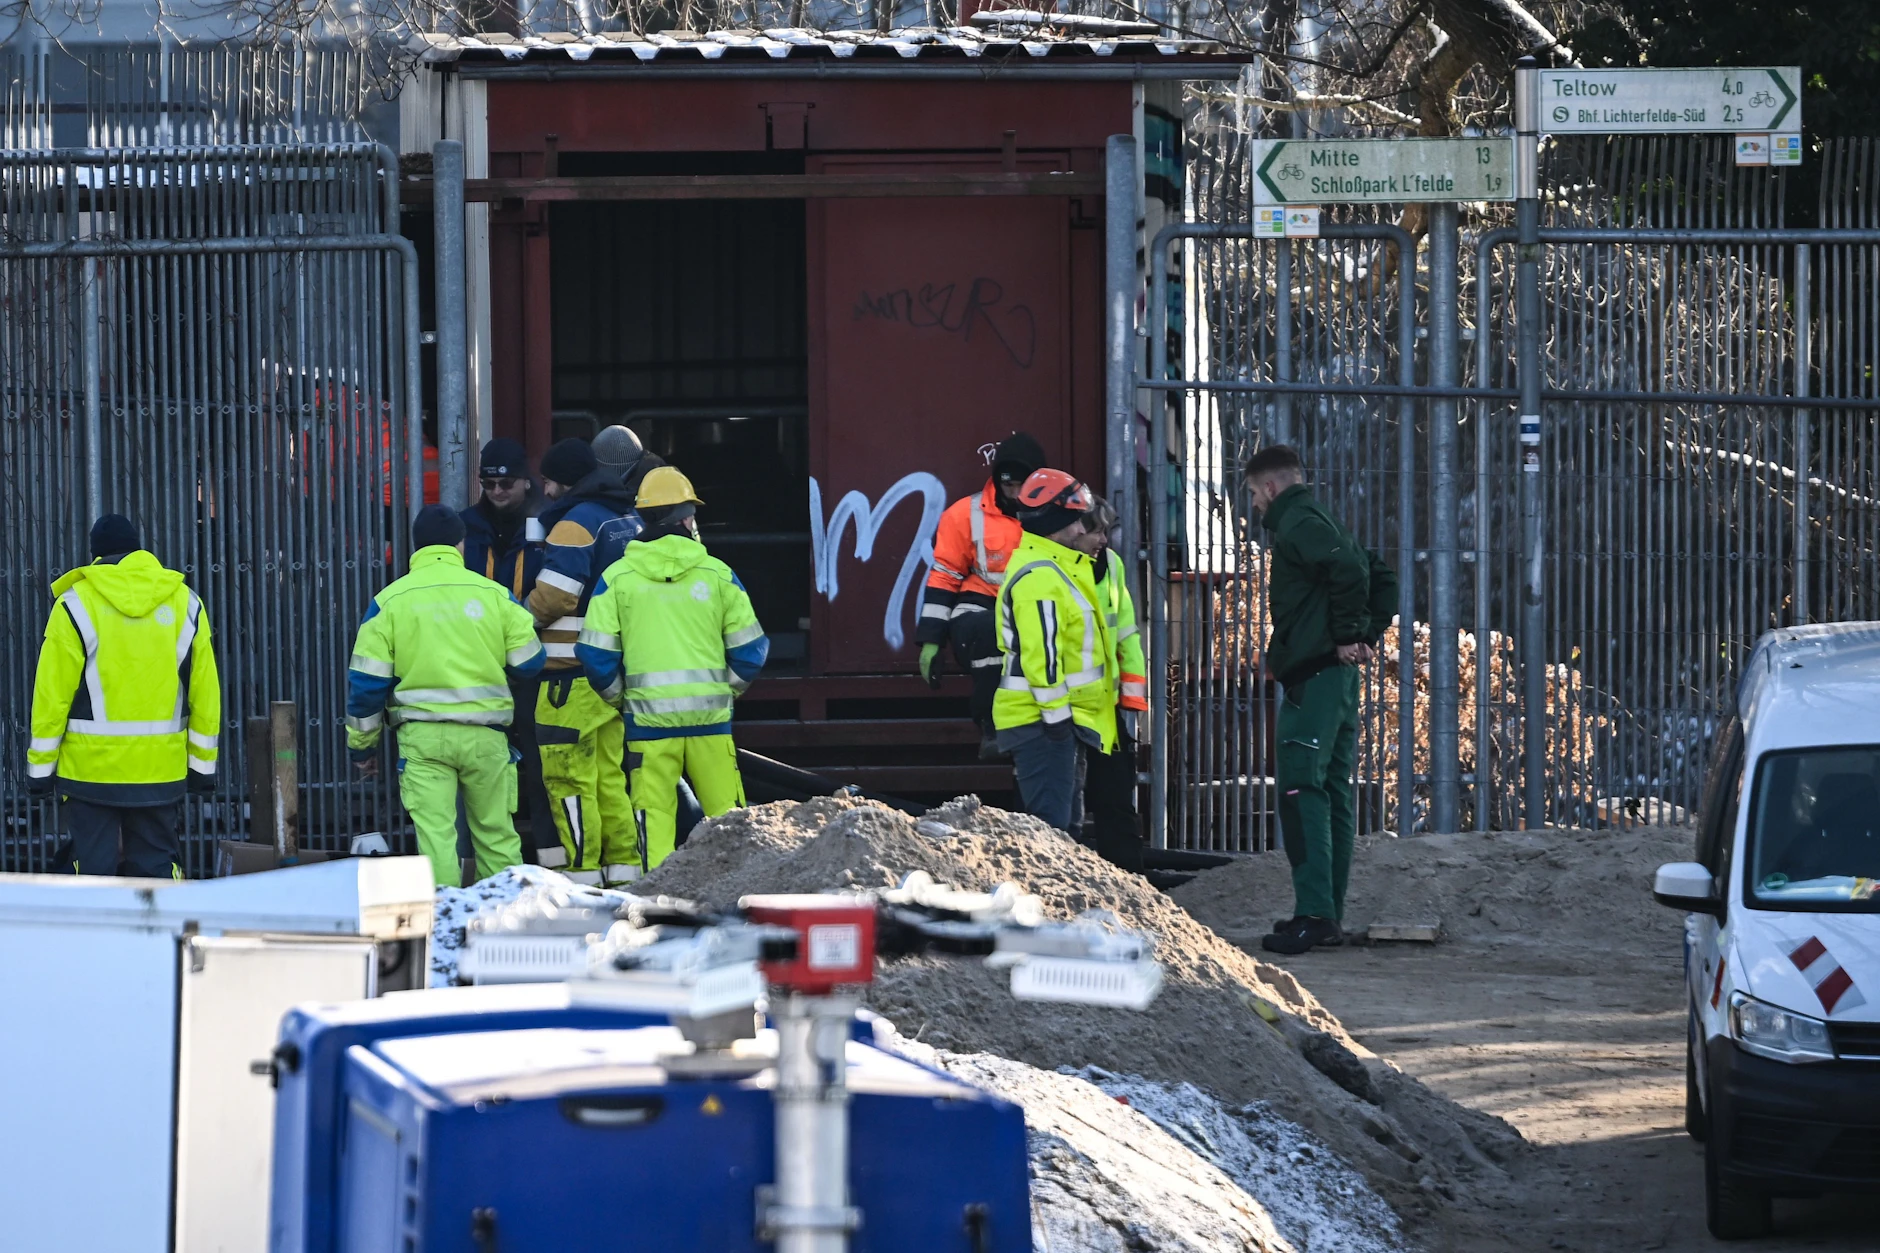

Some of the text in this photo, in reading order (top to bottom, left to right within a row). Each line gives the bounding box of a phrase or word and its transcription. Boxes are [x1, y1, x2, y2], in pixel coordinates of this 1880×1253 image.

[1552, 79, 1616, 97] Teltow
[1578, 109, 1600, 123] Bhf.
[1604, 108, 1705, 123] Lichterfelde-Süd
[1310, 146, 1490, 167] Mitte 13
[1311, 175, 1398, 197] Schloßpark
